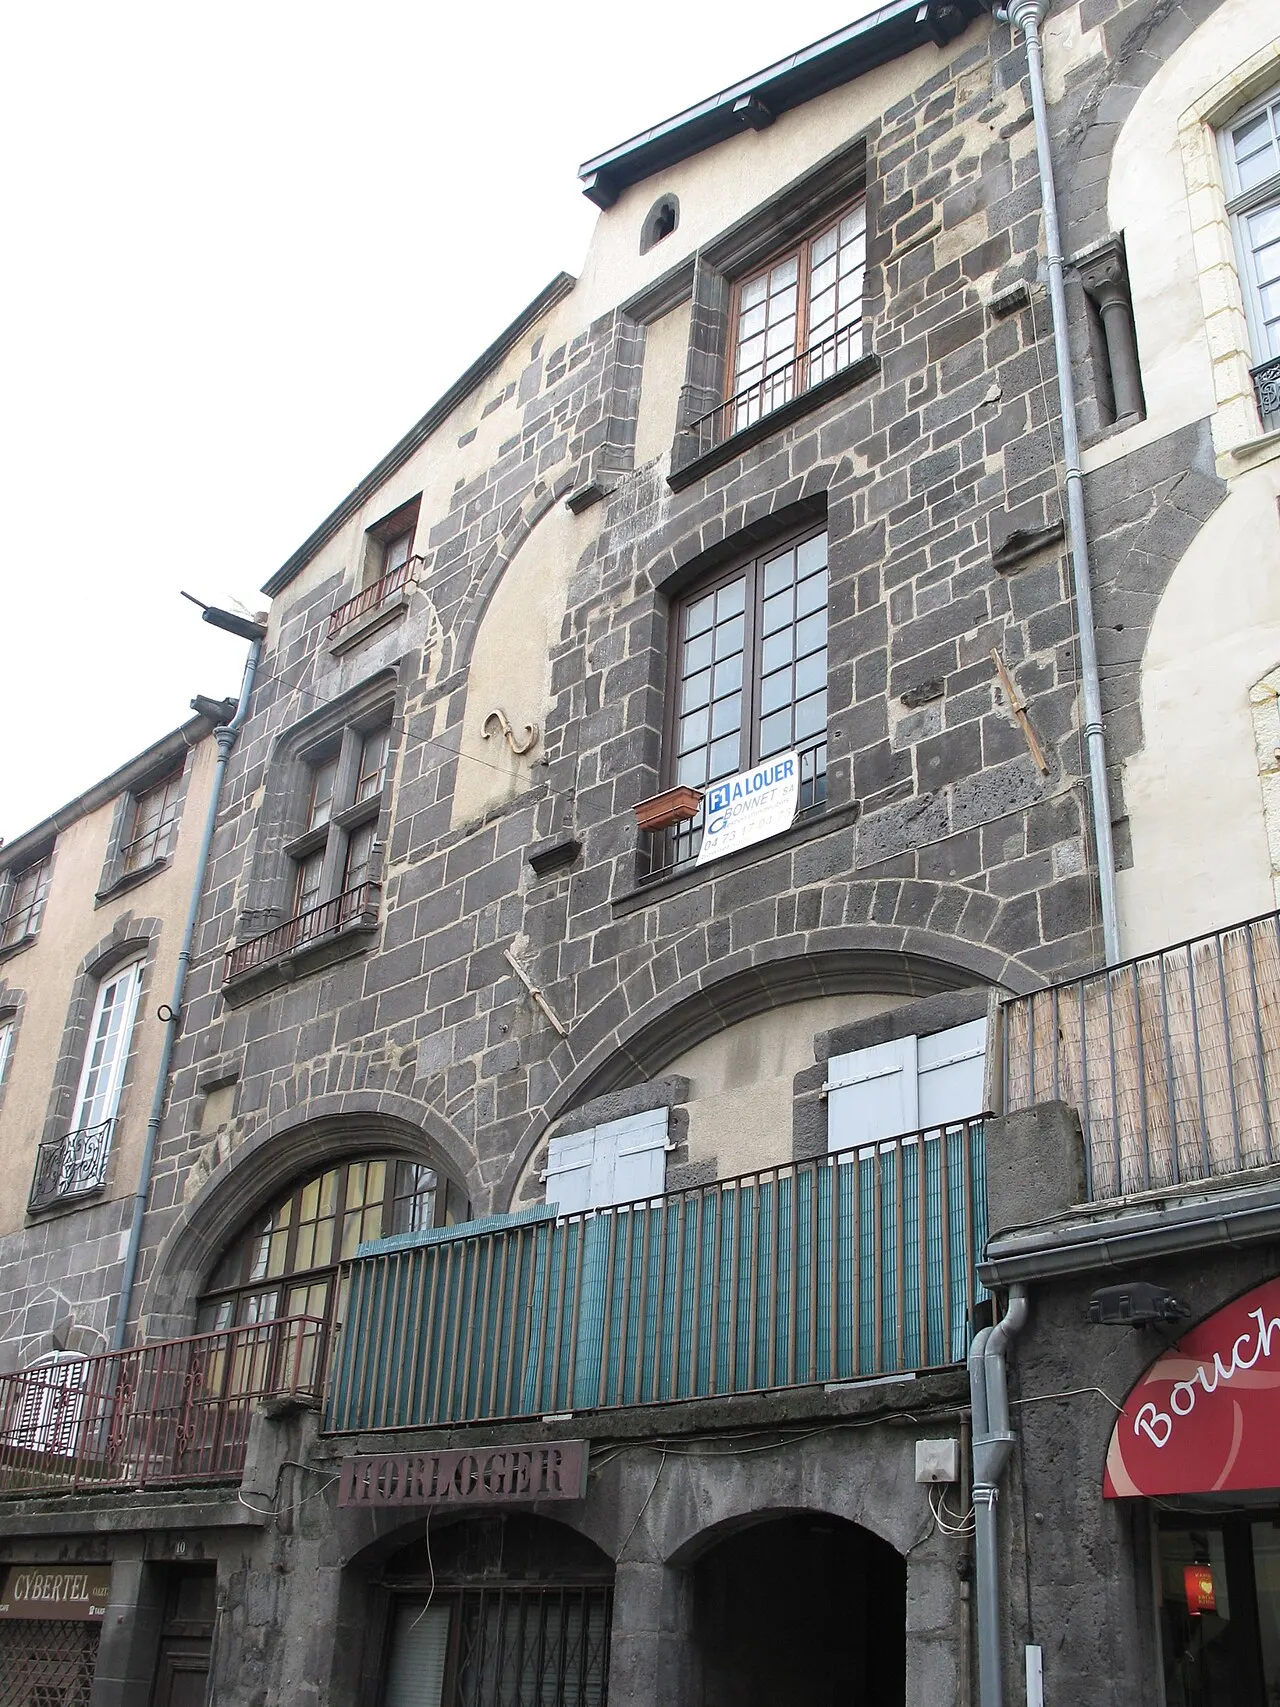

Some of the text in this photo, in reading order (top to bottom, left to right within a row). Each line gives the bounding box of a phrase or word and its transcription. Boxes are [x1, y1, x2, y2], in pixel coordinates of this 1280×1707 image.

[732, 782, 743, 801] A
[745, 759, 794, 796] LOUER
[723, 784, 794, 820] BONNET SA
[348, 1449, 563, 1500] HORLOGER
[176, 1541, 186, 1553] 10
[14, 1571, 90, 1601] CYBERTEL
